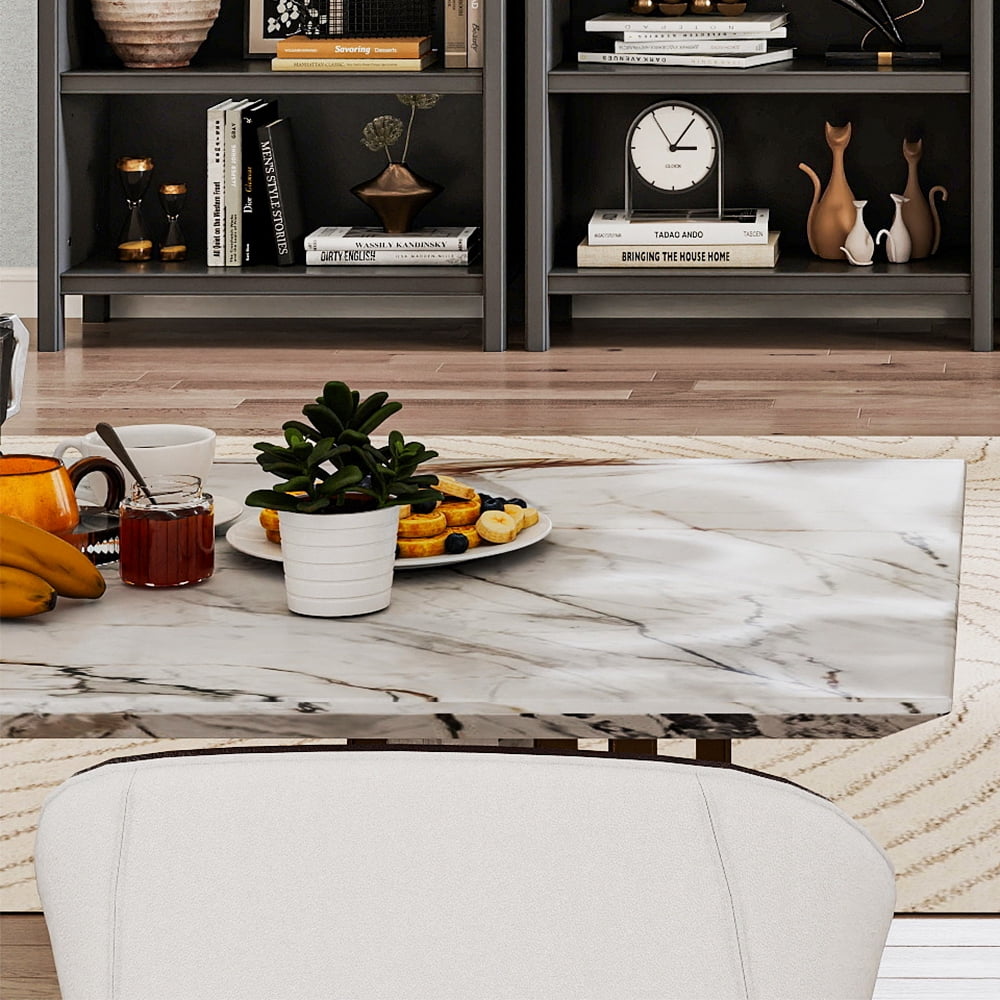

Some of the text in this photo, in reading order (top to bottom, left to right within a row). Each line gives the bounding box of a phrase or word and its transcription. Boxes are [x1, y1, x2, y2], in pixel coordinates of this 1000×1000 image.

[334, 45, 371, 55] Savoring
[265, 175, 280, 209] STYLE
[213, 196, 221, 217] Western
[243, 197, 252, 213] Dior
[213, 218, 221, 227] the
[272, 210, 289, 255] STORIES
[320, 250, 376, 261] DIRTY ENGLISH
[622, 252, 730, 262] BRINGING THE HOUSE HOME
